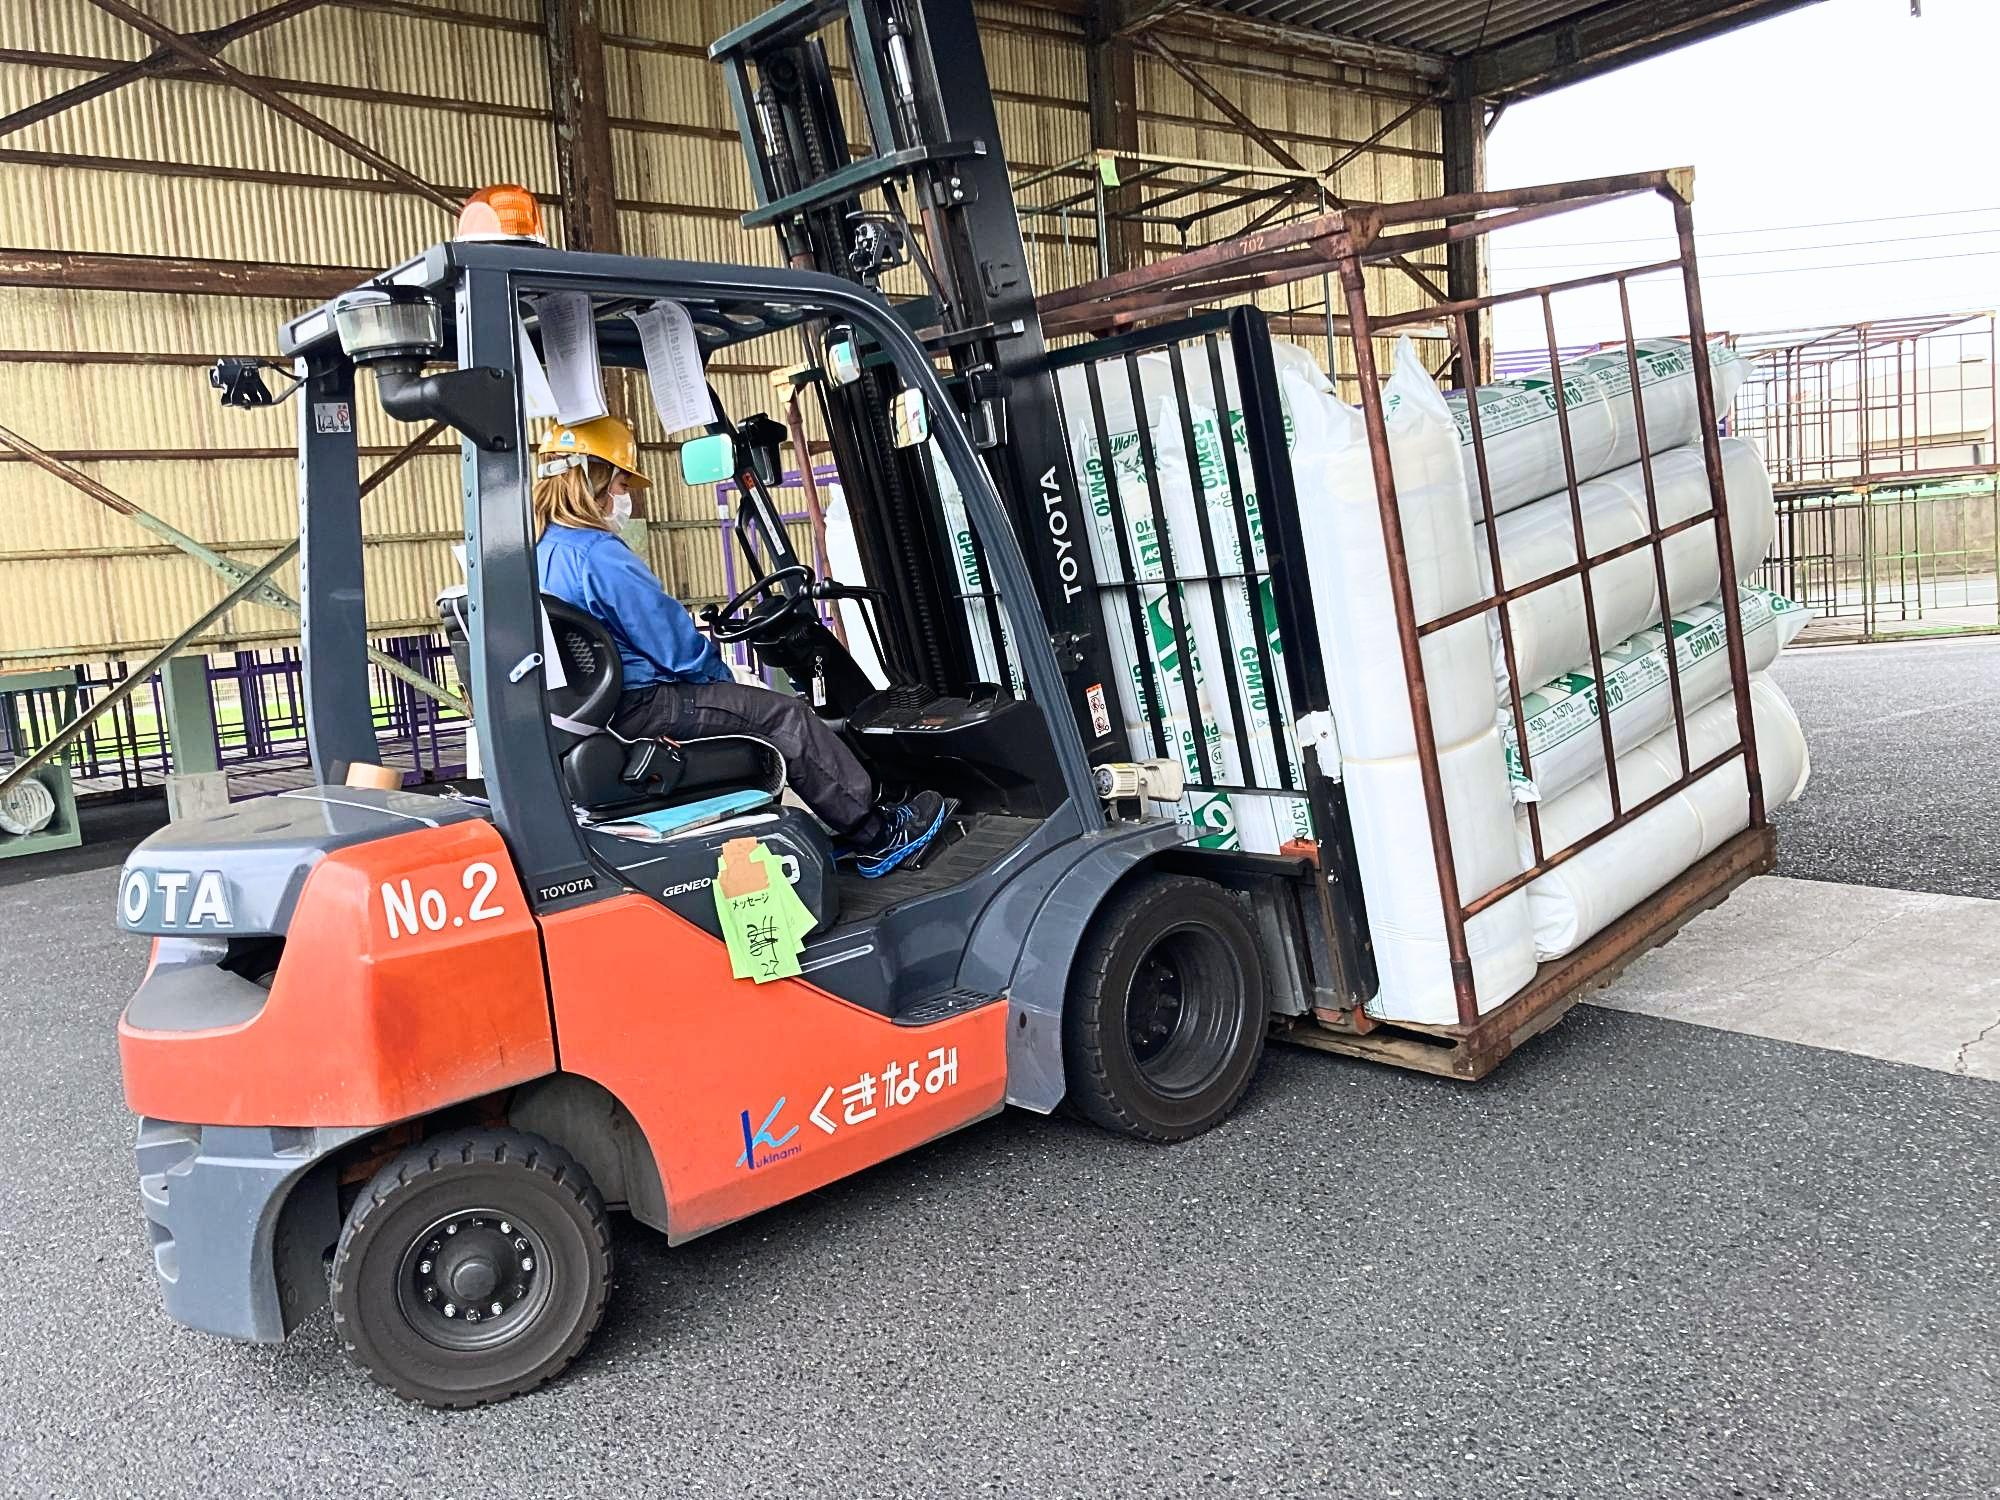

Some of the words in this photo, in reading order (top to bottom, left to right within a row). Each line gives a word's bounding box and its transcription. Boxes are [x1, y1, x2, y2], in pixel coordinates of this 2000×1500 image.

[1239, 236, 1266, 256] 702
[1651, 357, 1684, 379] GPM10
[1545, 388, 1583, 411] GM10
[1085, 458, 1111, 517] GPM10
[1220, 490, 1233, 508] 50
[1039, 465, 1082, 604] TOYOTA
[1690, 631, 1720, 659] GPM10
[1240, 646, 1267, 711] GPM10
[1588, 685, 1624, 718] GM10
[1616, 670, 1629, 684] 50
[1530, 717, 1547, 733] 430
[540, 878, 594, 900] TOYOTA
[663, 876, 712, 898] GENEO
[380, 861, 505, 940] No.2
[732, 893, 770, 912] メッセージ
[809, 1046, 959, 1136] くきなみ
